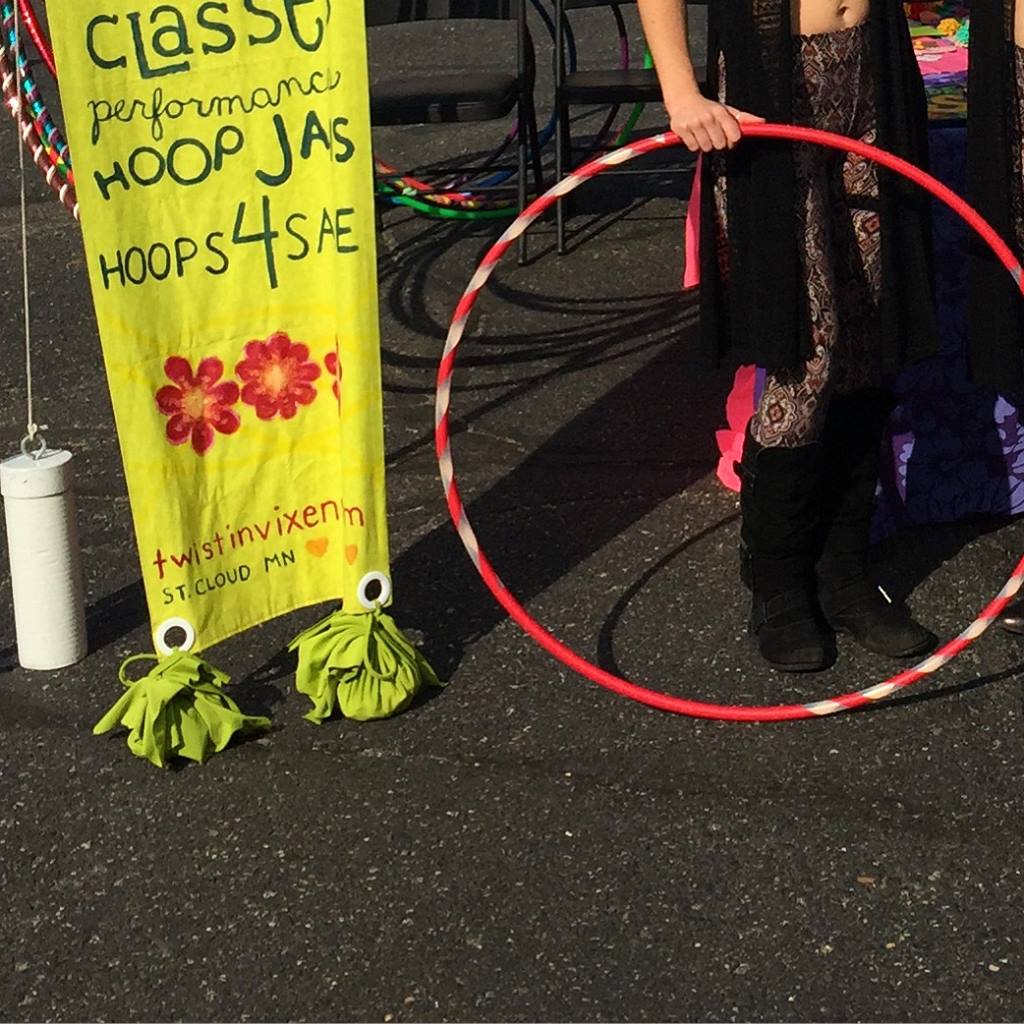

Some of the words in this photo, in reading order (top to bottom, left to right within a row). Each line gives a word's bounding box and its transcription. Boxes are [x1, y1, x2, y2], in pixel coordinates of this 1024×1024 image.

[93, 125, 244, 200] HOOP
[255, 110, 356, 187] JAS
[99, 231, 229, 290] HOOPS
[231, 195, 279, 290] 4
[285, 207, 360, 262] SAE
[264, 549, 296, 573] MN
